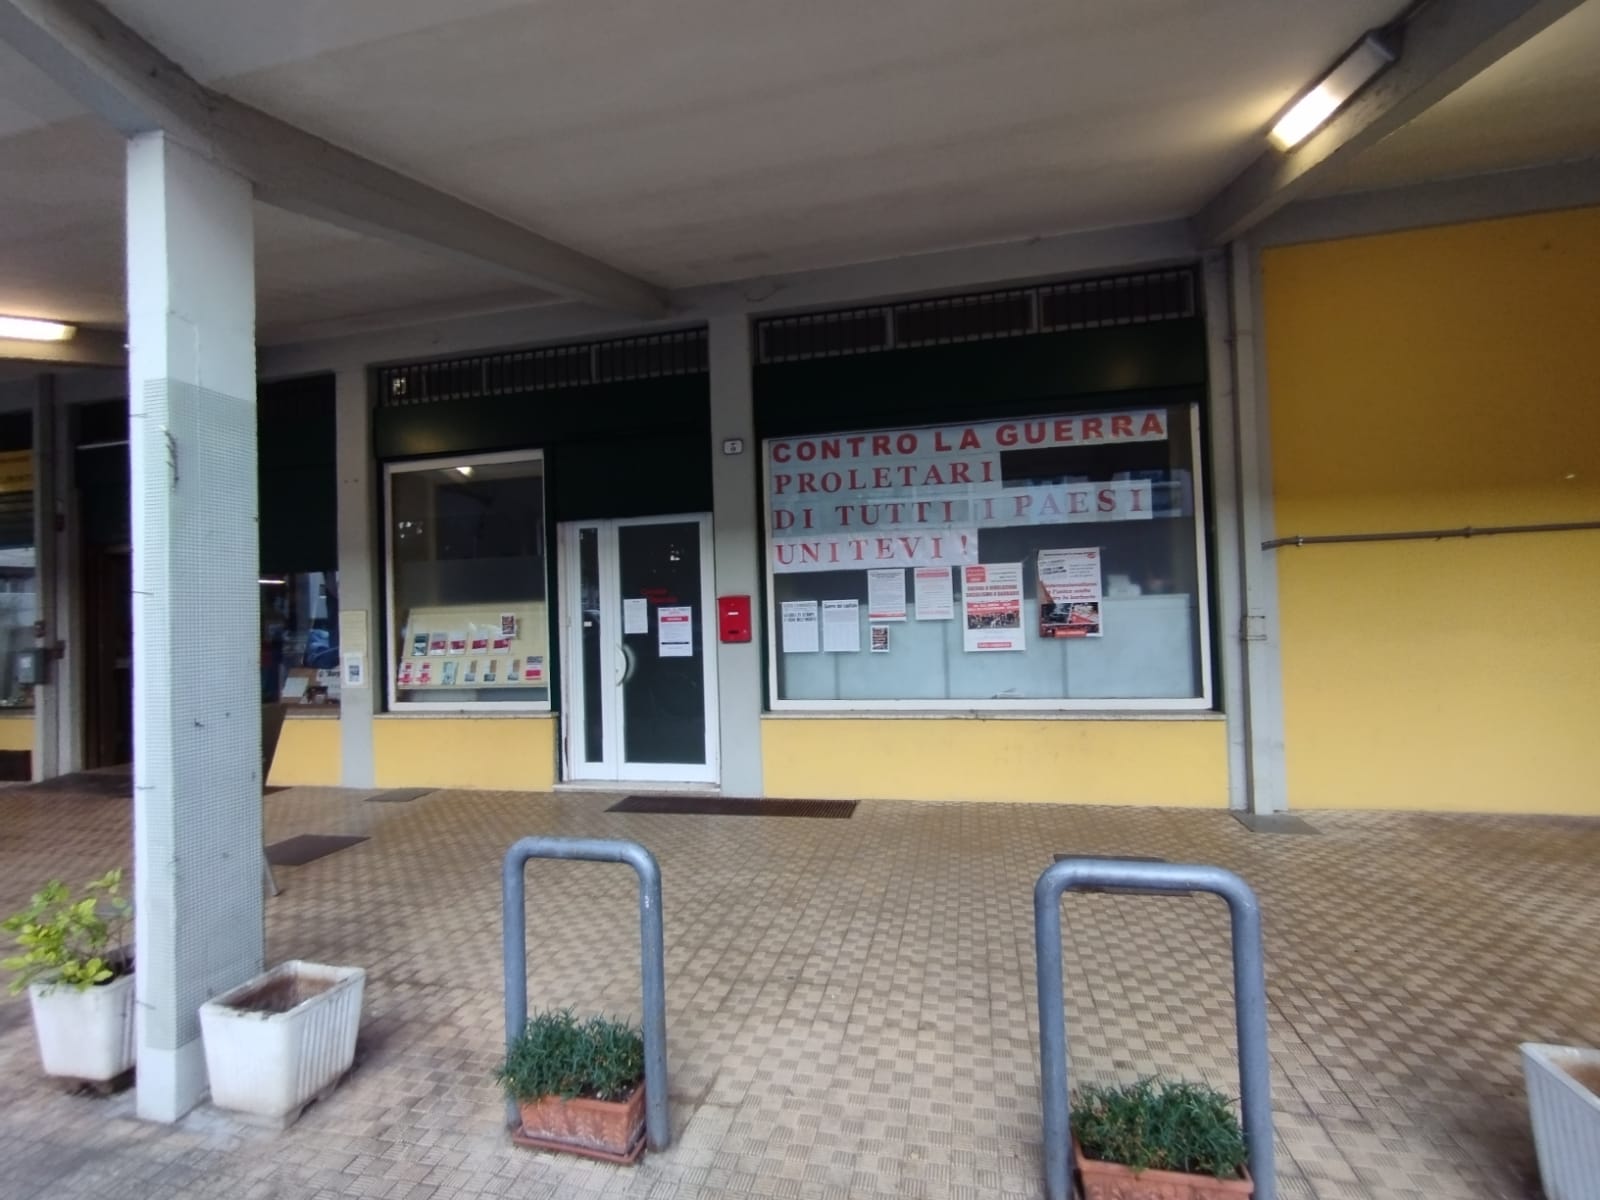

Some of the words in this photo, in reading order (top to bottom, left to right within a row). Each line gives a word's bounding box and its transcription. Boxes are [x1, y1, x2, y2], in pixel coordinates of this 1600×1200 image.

[772, 433, 918, 463] CONTRO
[935, 428, 981, 452] LA
[996, 412, 1164, 446] GUERRA
[774, 461, 993, 495] PROLETARI
[774, 508, 814, 530] DI
[835, 501, 955, 527] TUTTI
[983, 497, 998, 520] I
[1013, 489, 1143, 518] PAESI
